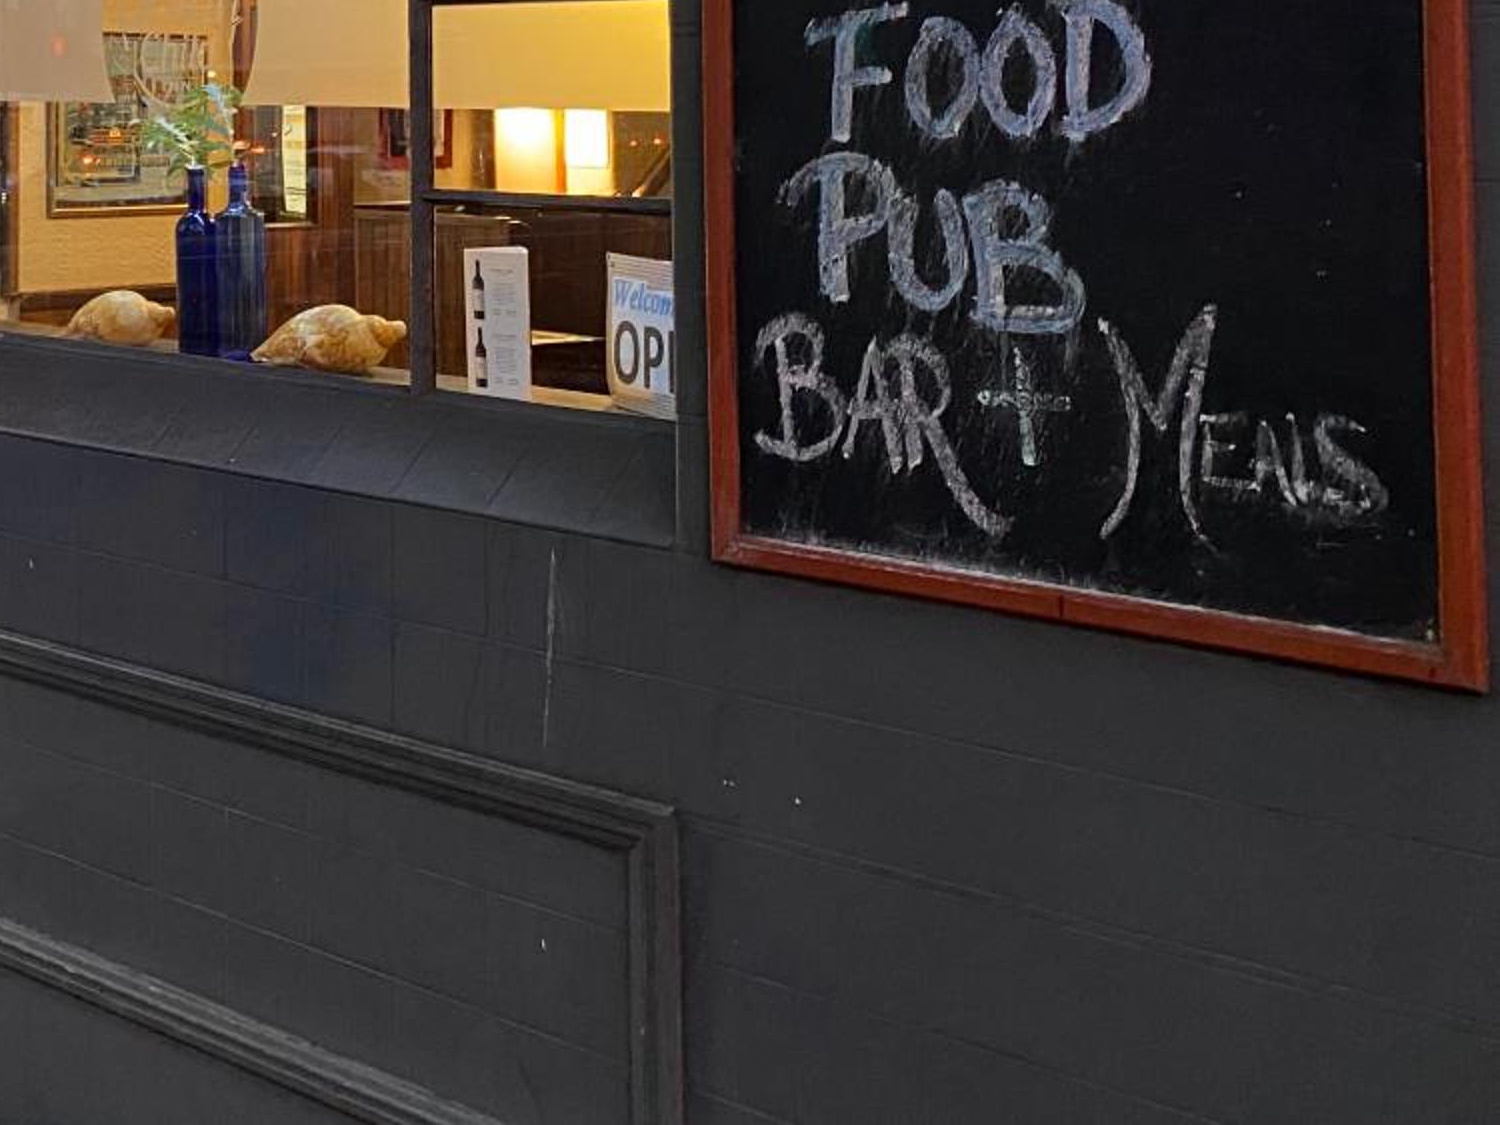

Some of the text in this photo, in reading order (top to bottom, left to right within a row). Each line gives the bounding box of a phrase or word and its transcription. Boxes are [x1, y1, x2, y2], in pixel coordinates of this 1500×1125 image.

[613, 279, 674, 316] Welcom
[777, 151, 1087, 334] PUB
[752, 311, 1012, 539] BAR
